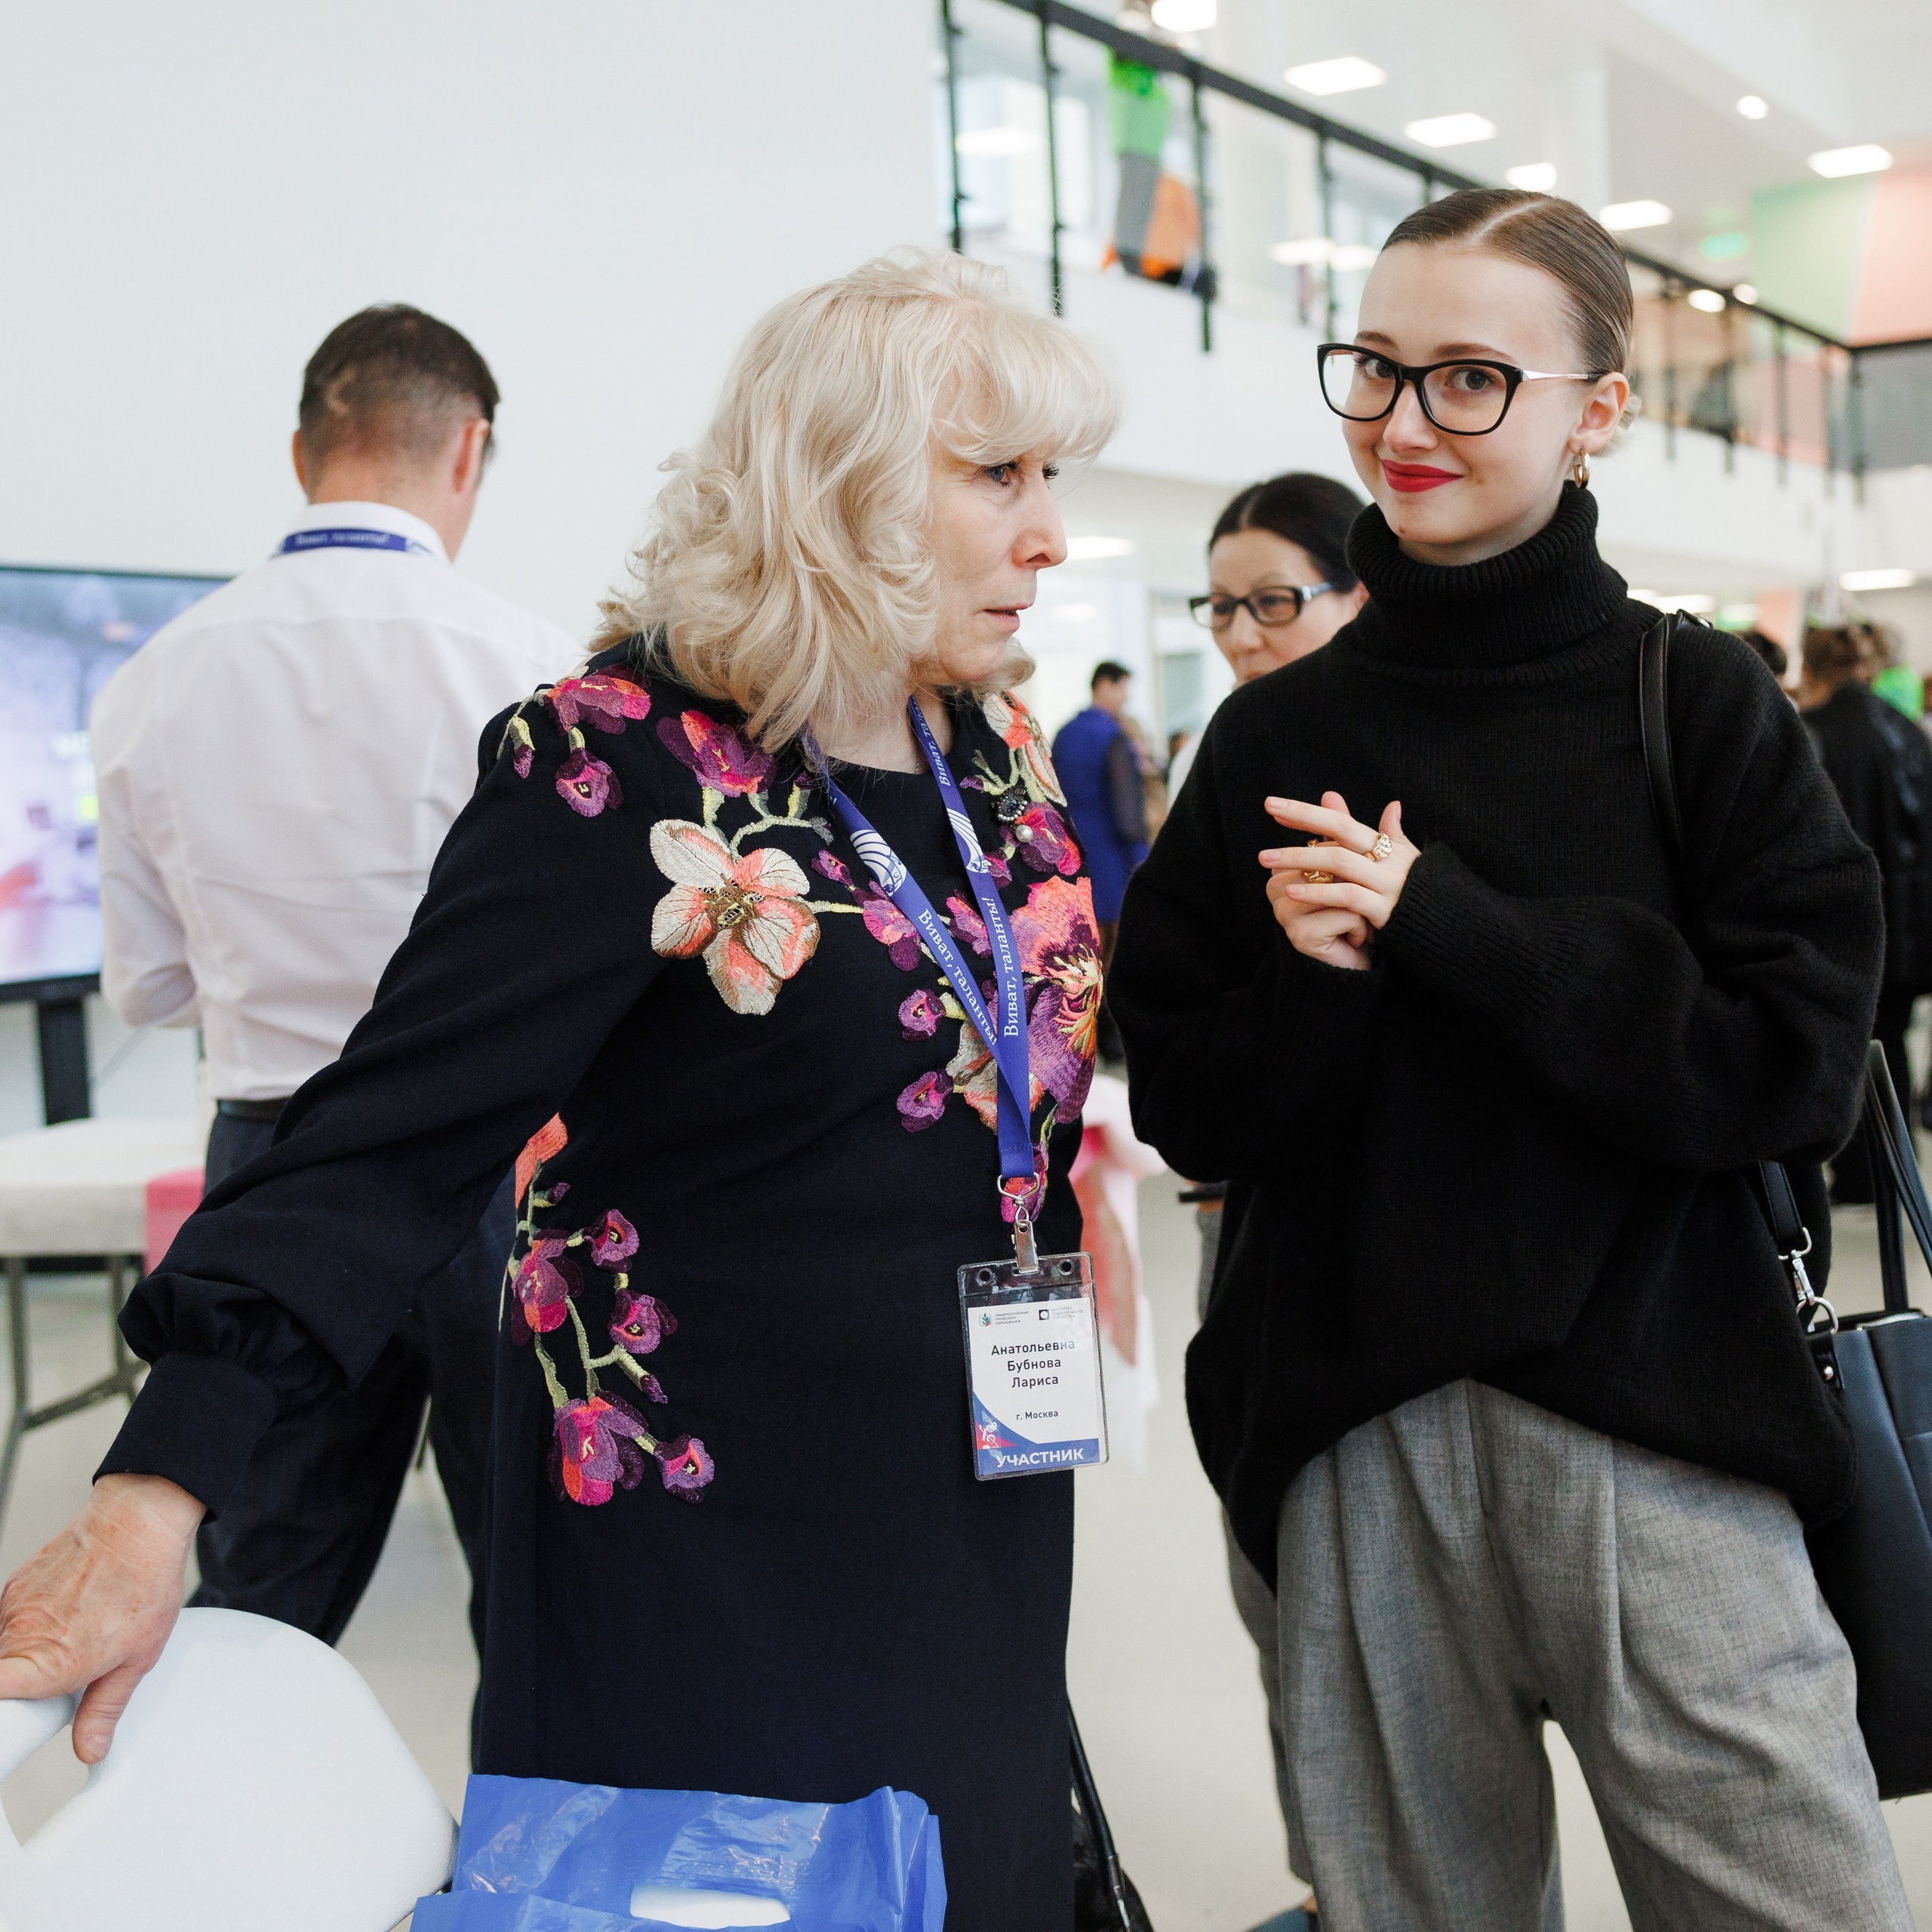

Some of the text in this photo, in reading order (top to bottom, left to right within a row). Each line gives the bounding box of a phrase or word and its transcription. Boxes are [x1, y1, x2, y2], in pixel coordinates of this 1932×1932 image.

[981, 897, 1019, 1037] Виват, таланты!
[918, 908, 997, 1045] Виват, таланты!
[991, 1340, 1075, 1355] Анатольевна
[1008, 1358, 1061, 1373] Бубнова
[1011, 1376, 1059, 1389] Лариса
[1025, 1410, 1058, 1420] Москва
[997, 1447, 1084, 1468] УЧАСТНИК
